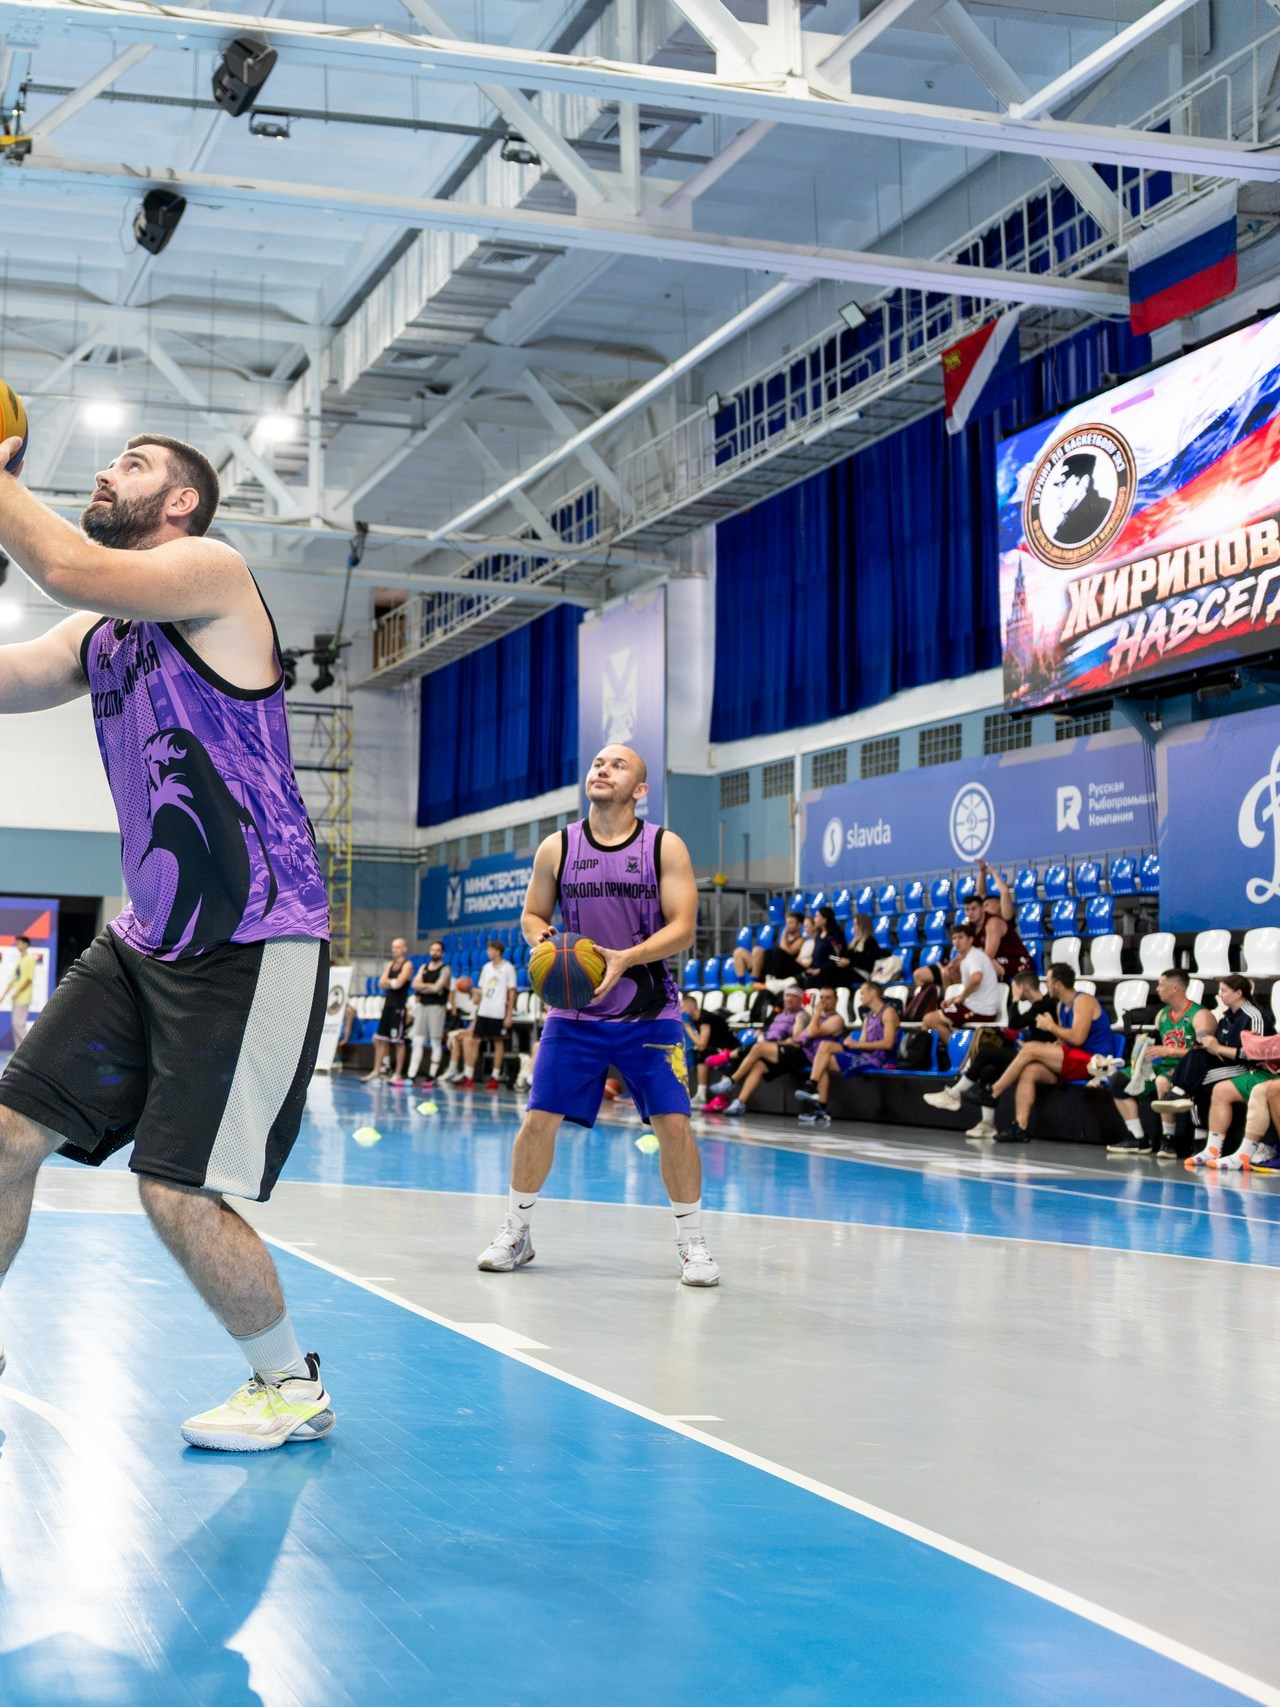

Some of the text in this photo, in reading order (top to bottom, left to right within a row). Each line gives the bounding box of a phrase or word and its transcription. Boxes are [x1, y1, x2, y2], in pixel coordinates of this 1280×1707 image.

[1060, 518, 1280, 642] ЖИРИНОВ
[1089, 781, 1125, 797] Русская
[1089, 811, 1134, 827] Компания
[847, 818, 891, 850] slavda
[571, 859, 599, 871] ЛДПР
[563, 882, 656, 899] СОКОЛЫ ПРИМОРЬЯ
